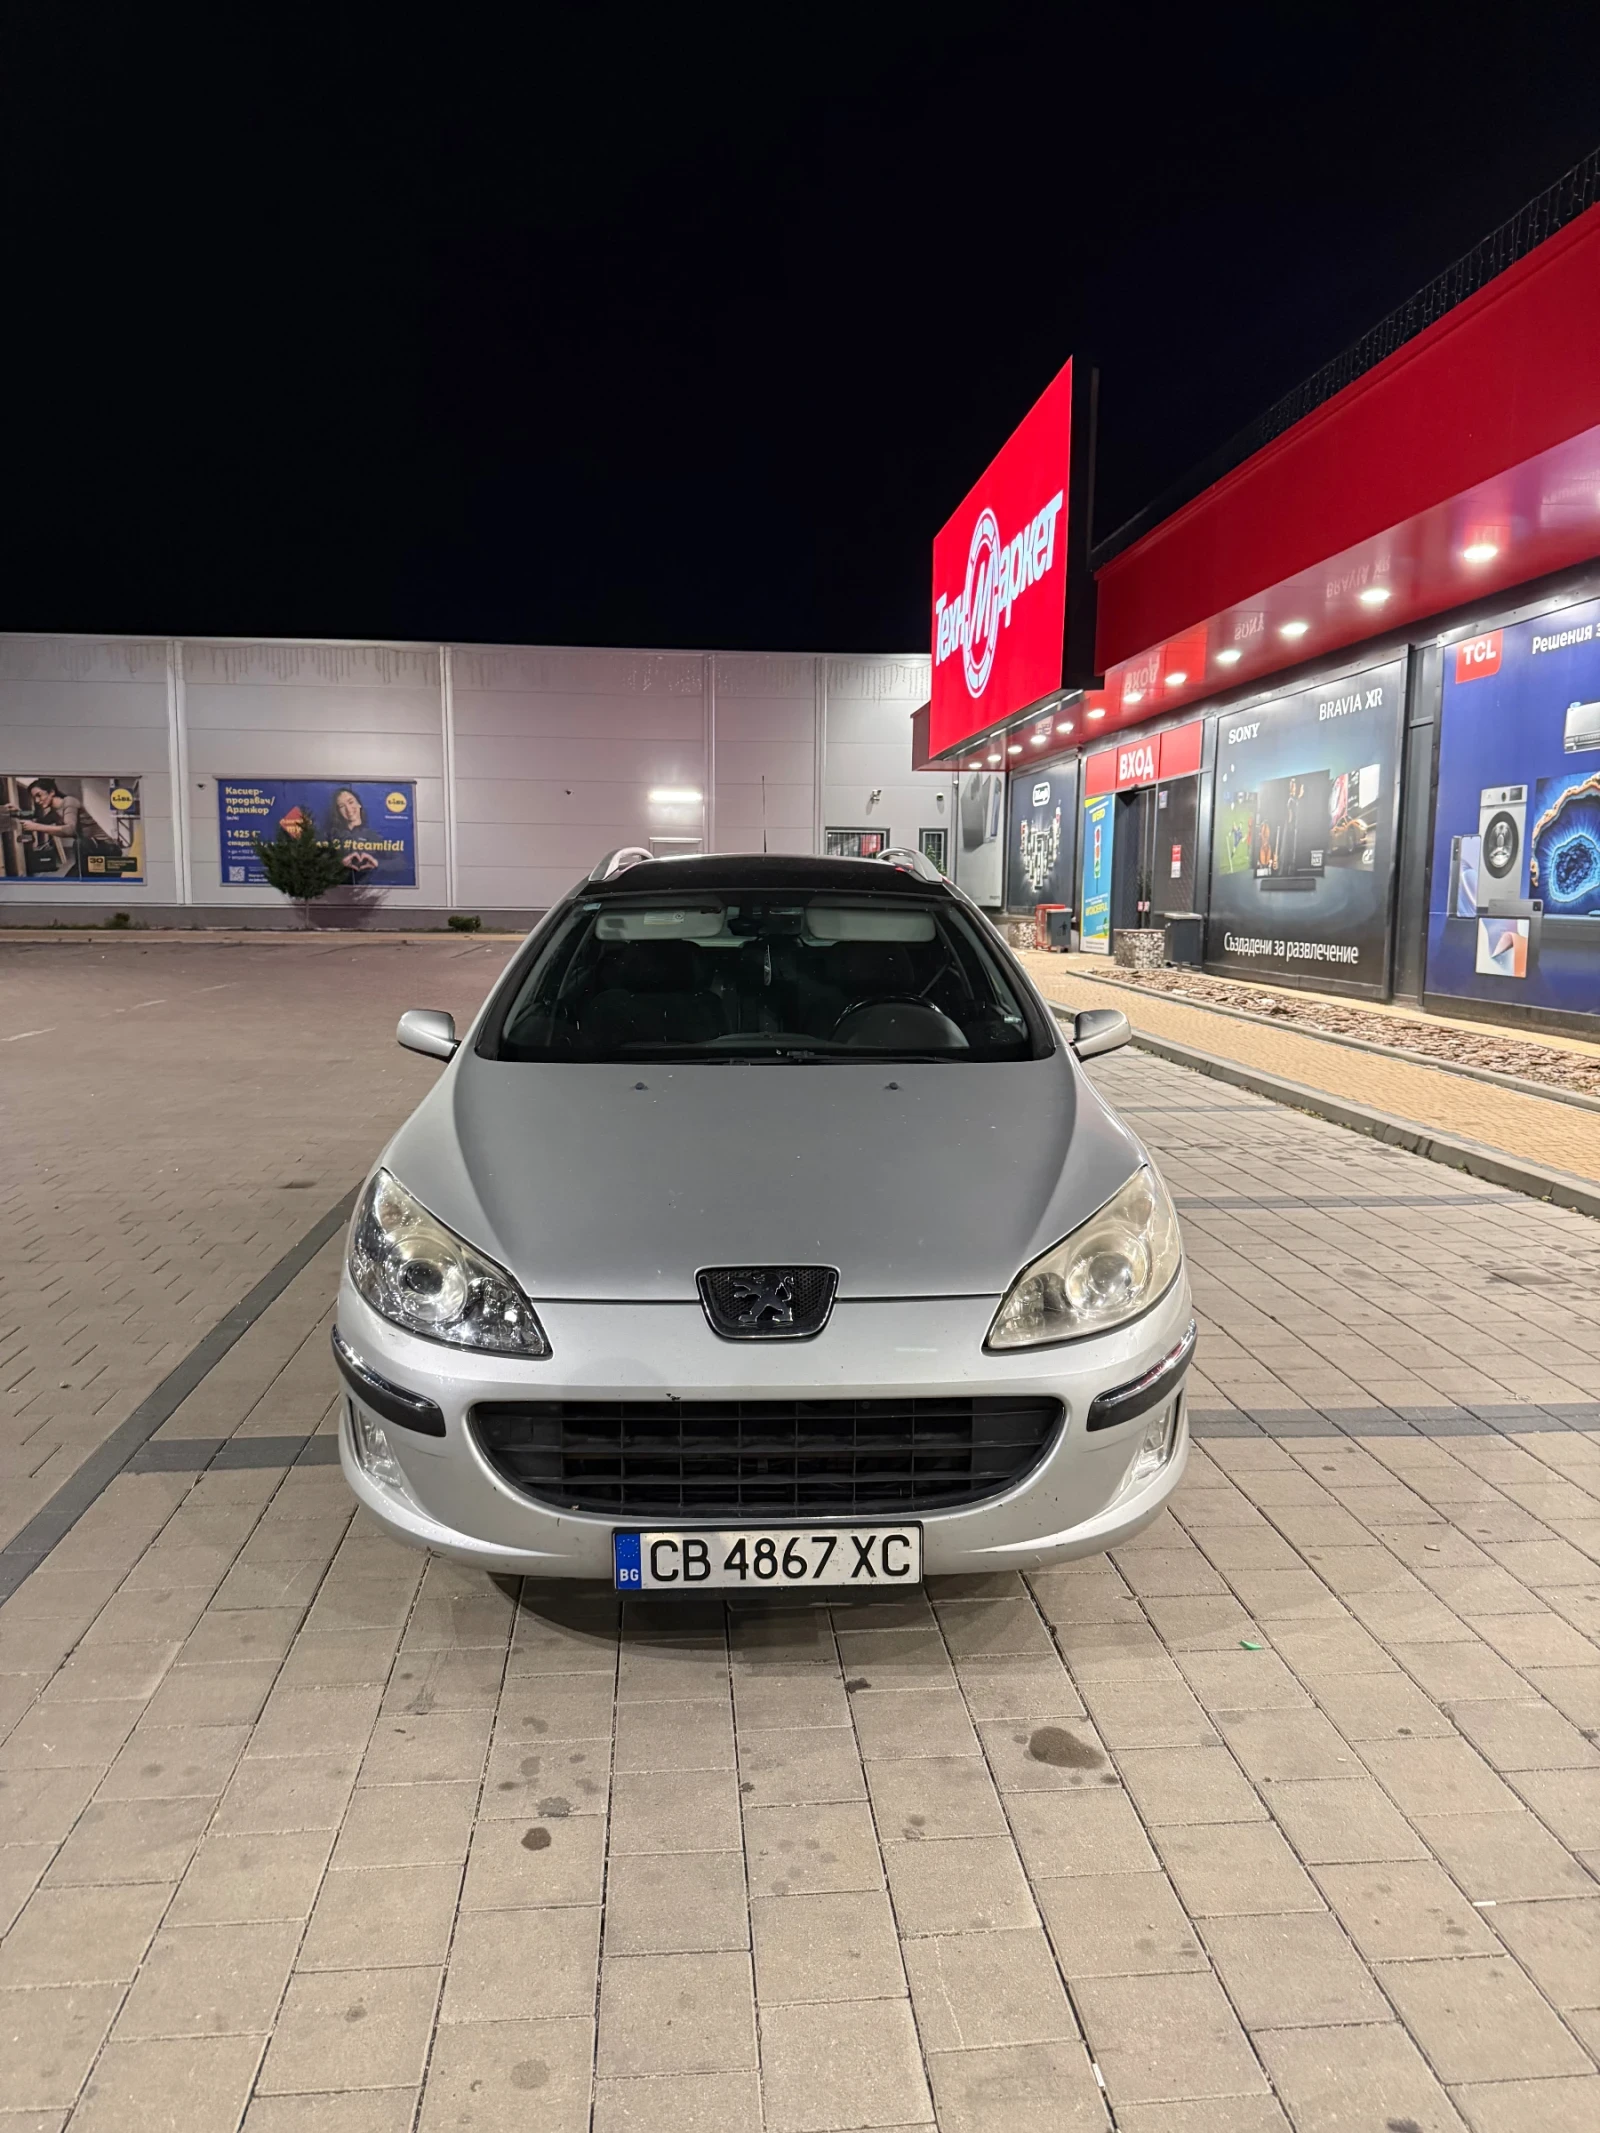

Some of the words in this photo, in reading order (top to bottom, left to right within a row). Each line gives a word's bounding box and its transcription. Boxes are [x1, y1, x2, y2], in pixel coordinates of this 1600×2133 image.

[1532, 624, 1593, 655] Решения
[1463, 639, 1497, 665] TCL
[1319, 693, 1362, 721] BRAVIA
[1365, 687, 1383, 709] XR
[1228, 722, 1260, 744] SONY
[1119, 745, 1154, 781] ВХОД
[225, 786, 264, 796] Касиер-
[225, 796, 275, 806] продавач/
[226, 805, 270, 816] Аранжор
[233, 830, 250, 838] 425
[343, 840, 404, 852] #teamlidl
[1224, 931, 1272, 957] Създадени
[1273, 940, 1284, 956] за
[1286, 940, 1359, 965] развлечение
[650, 1539, 711, 1582] CB
[723, 1536, 837, 1580] 4867
[850, 1534, 910, 1577] XC
[619, 1569, 639, 1581] BG
